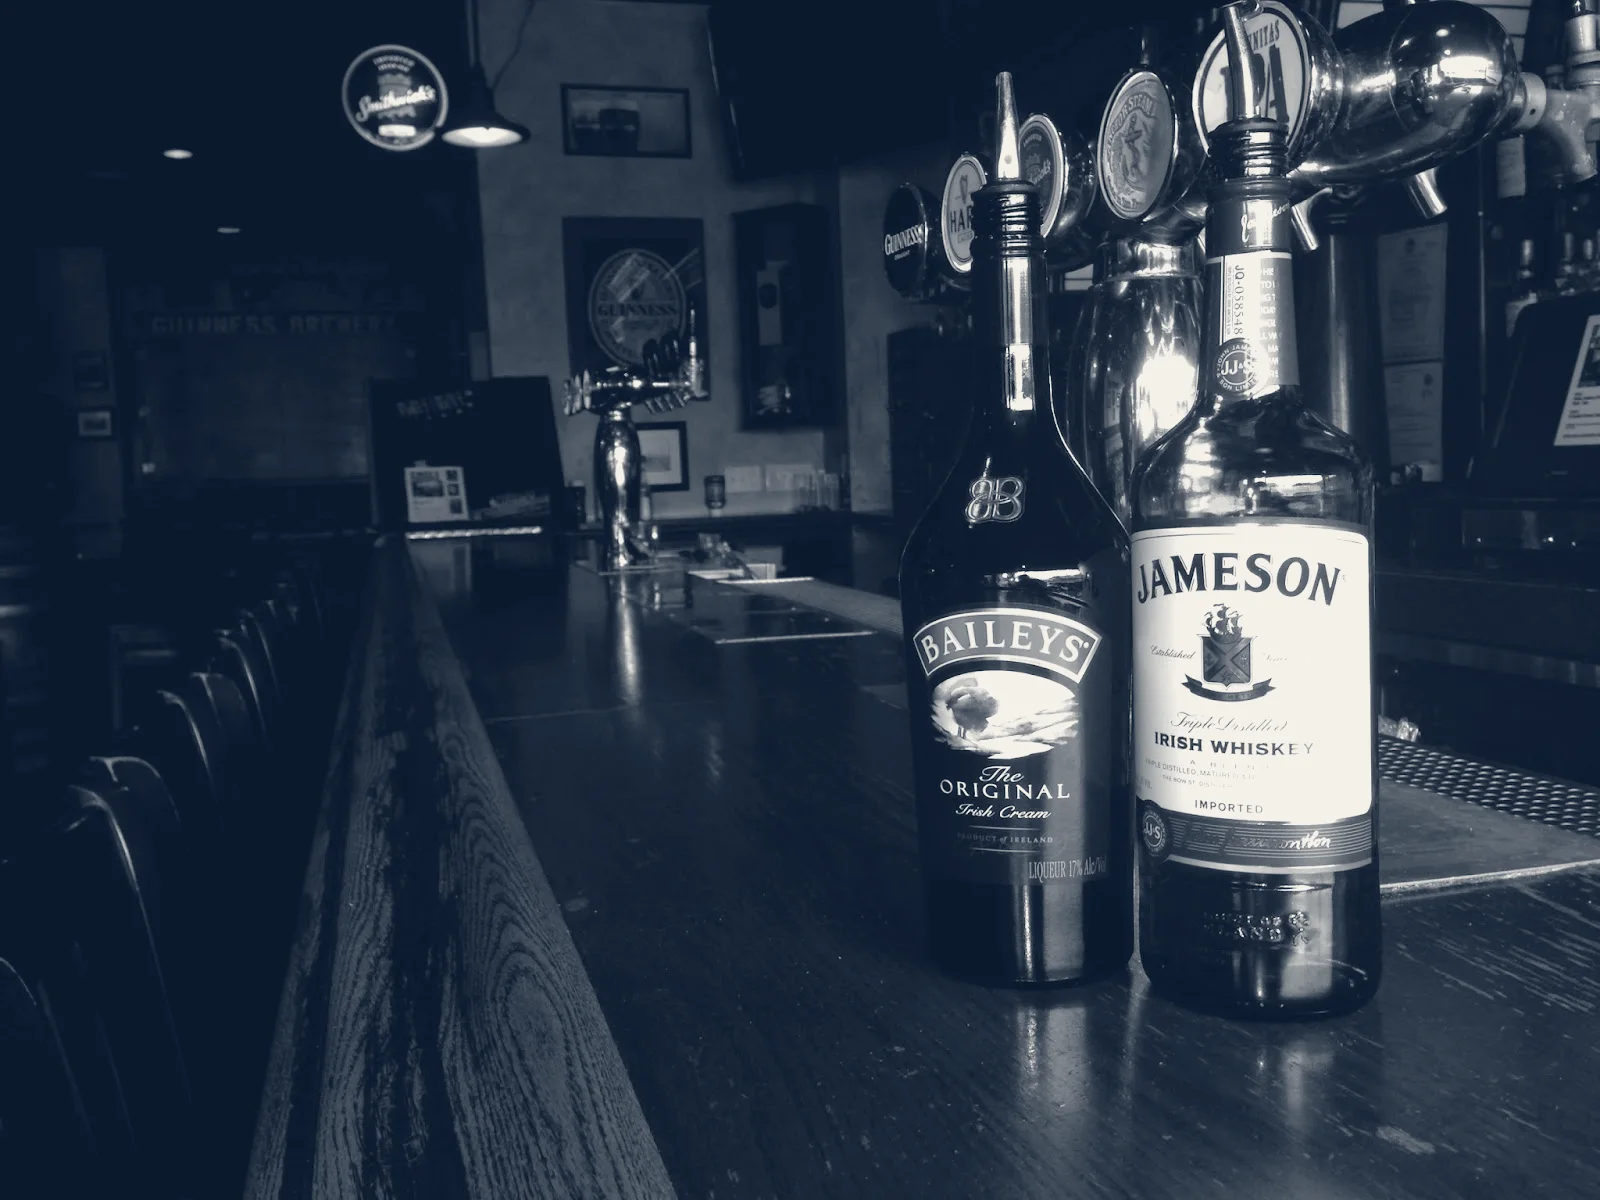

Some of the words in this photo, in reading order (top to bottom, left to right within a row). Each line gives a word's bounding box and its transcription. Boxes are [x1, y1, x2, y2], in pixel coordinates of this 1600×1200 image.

[885, 224, 924, 256] GUINNESS
[1137, 552, 1341, 607] JAMESON
[920, 620, 1083, 665] BAILEYS
[1170, 711, 1216, 733] Triple
[1154, 731, 1203, 752] IRISH
[1210, 740, 1314, 756] WHISKEY
[979, 765, 1025, 783] The
[939, 779, 1071, 800] ORIGINAL
[955, 803, 996, 818] Irish
[999, 805, 1052, 819] Cream
[1194, 800, 1264, 814] IMPORTED
[1010, 836, 1054, 844] IRELAND
[1028, 861, 1066, 883] LIQUEUR
[1068, 859, 1083, 878] 17%
